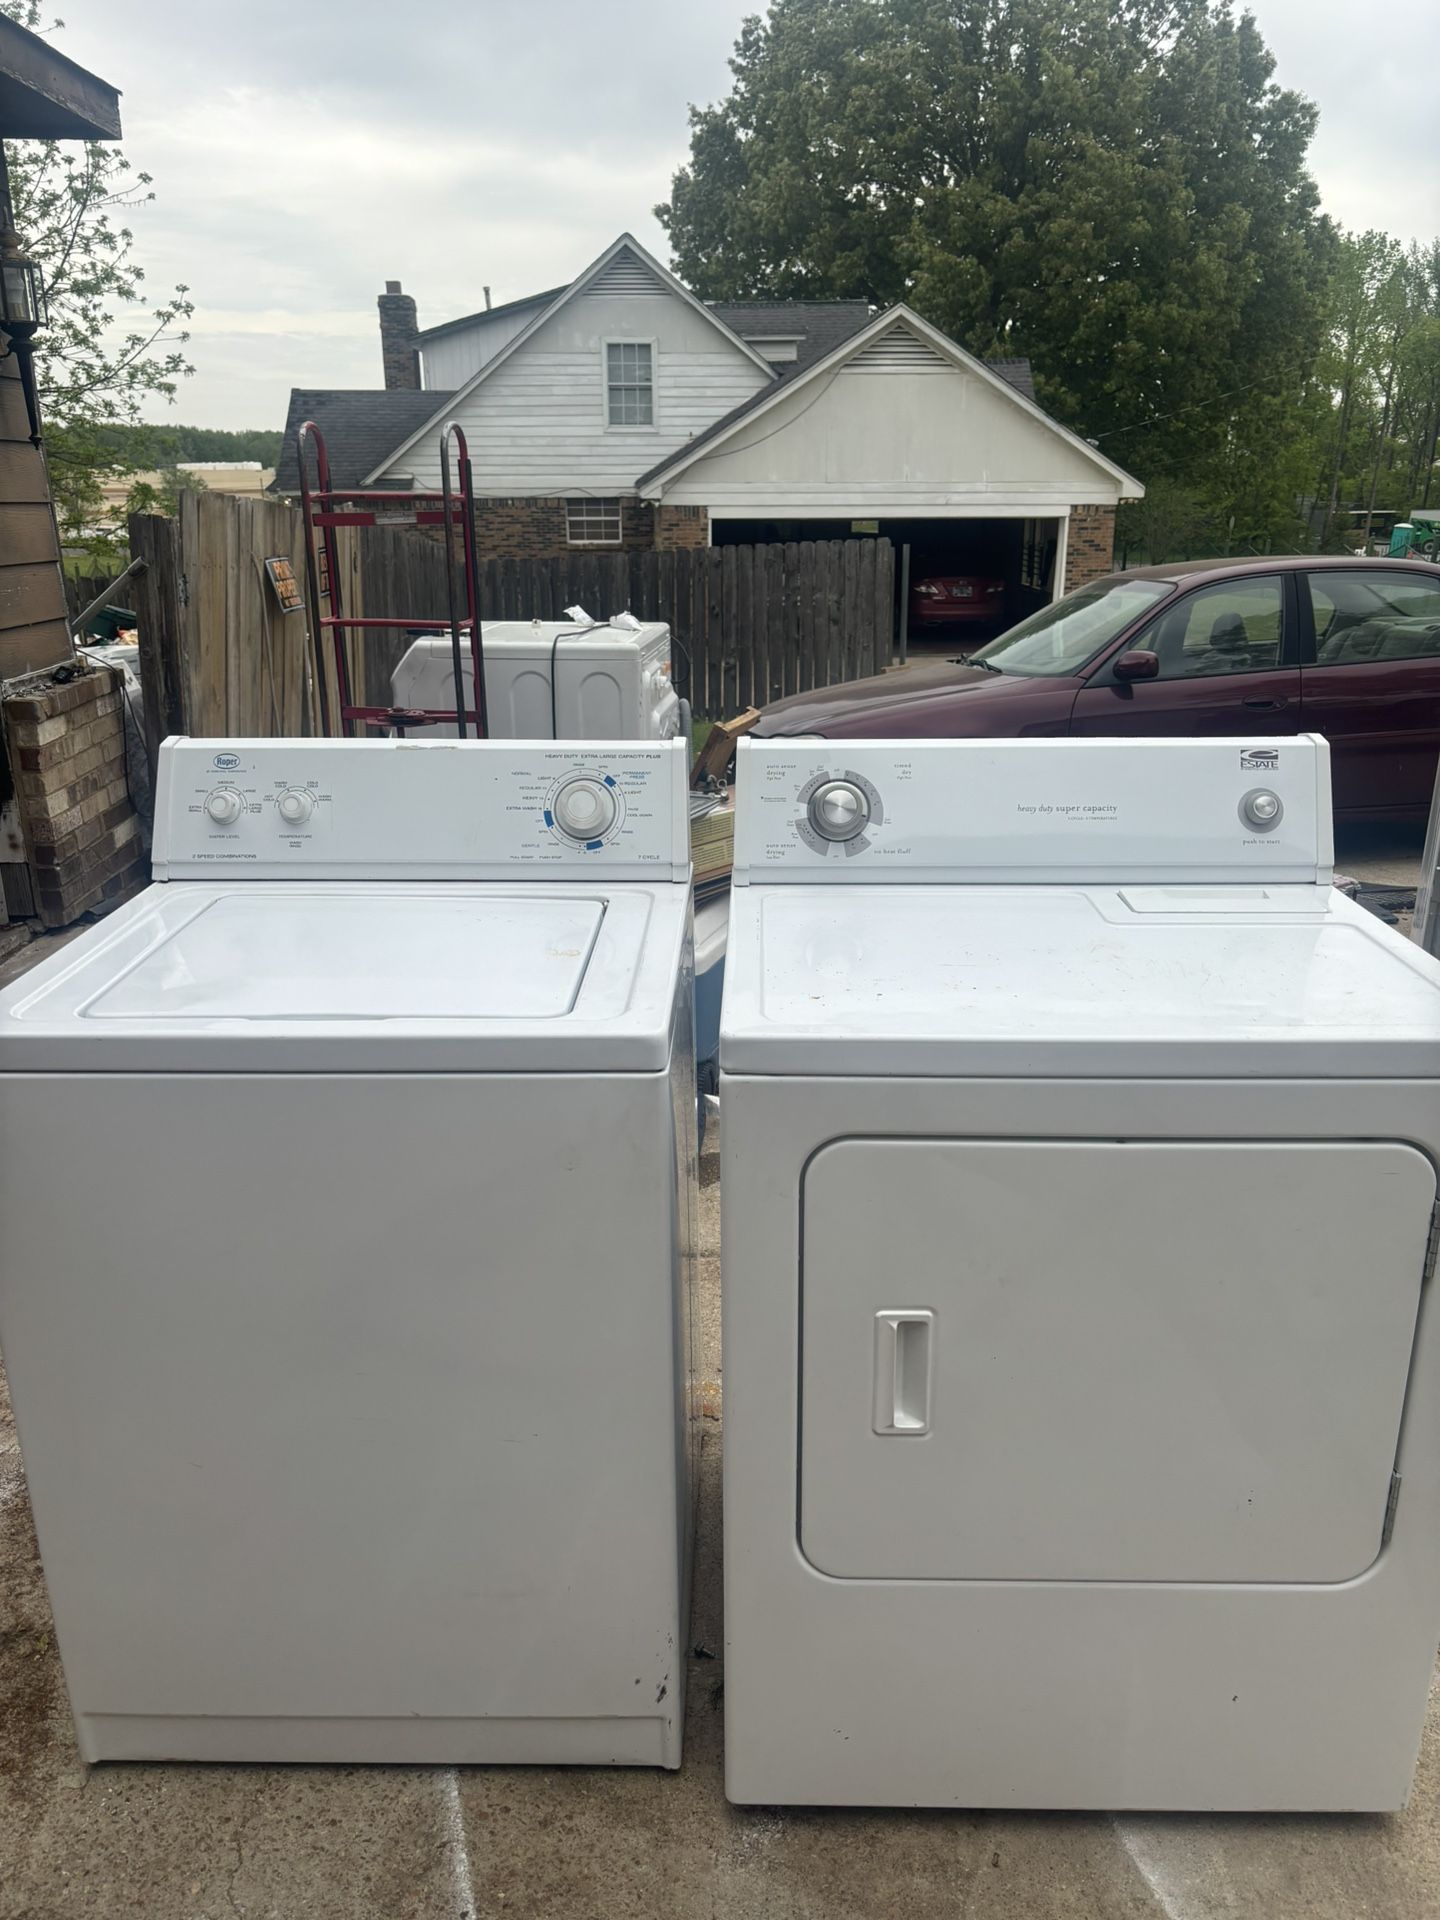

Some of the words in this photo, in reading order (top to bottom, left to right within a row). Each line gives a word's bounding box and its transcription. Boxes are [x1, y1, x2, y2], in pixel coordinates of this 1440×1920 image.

[216, 757, 238, 766] Roper
[767, 769, 786, 777] drying
[1018, 803, 1037, 815] heavy
[1038, 803, 1054, 815] duty
[1055, 805, 1081, 815] super
[1082, 805, 1118, 815] capacity
[1242, 837, 1258, 846] push
